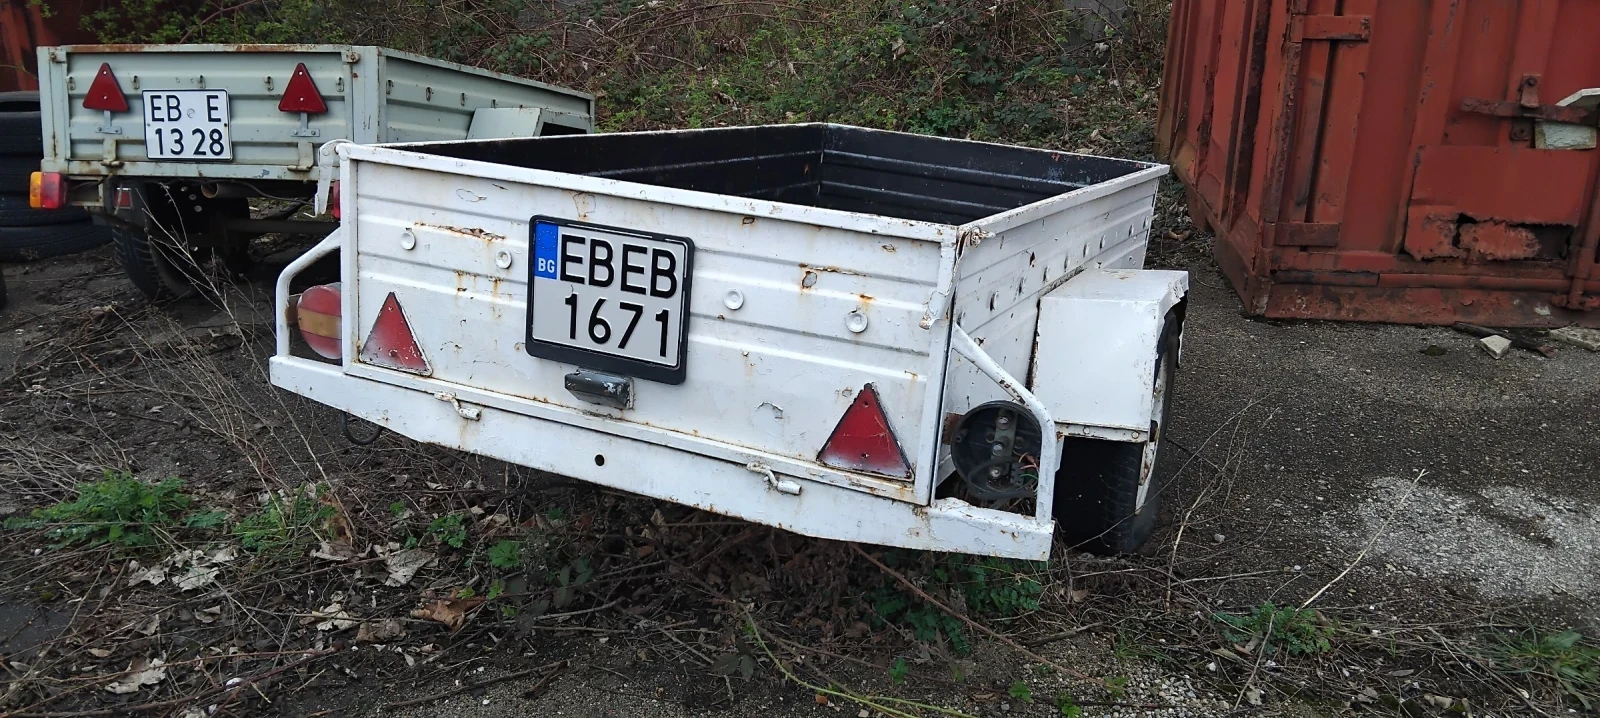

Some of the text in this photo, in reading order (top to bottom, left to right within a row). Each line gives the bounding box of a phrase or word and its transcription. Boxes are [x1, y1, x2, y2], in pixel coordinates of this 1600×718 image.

[150, 94, 222, 122] EB E
[538, 257, 555, 274] BG
[560, 234, 678, 299] EBEB
[564, 292, 669, 358] 1671
